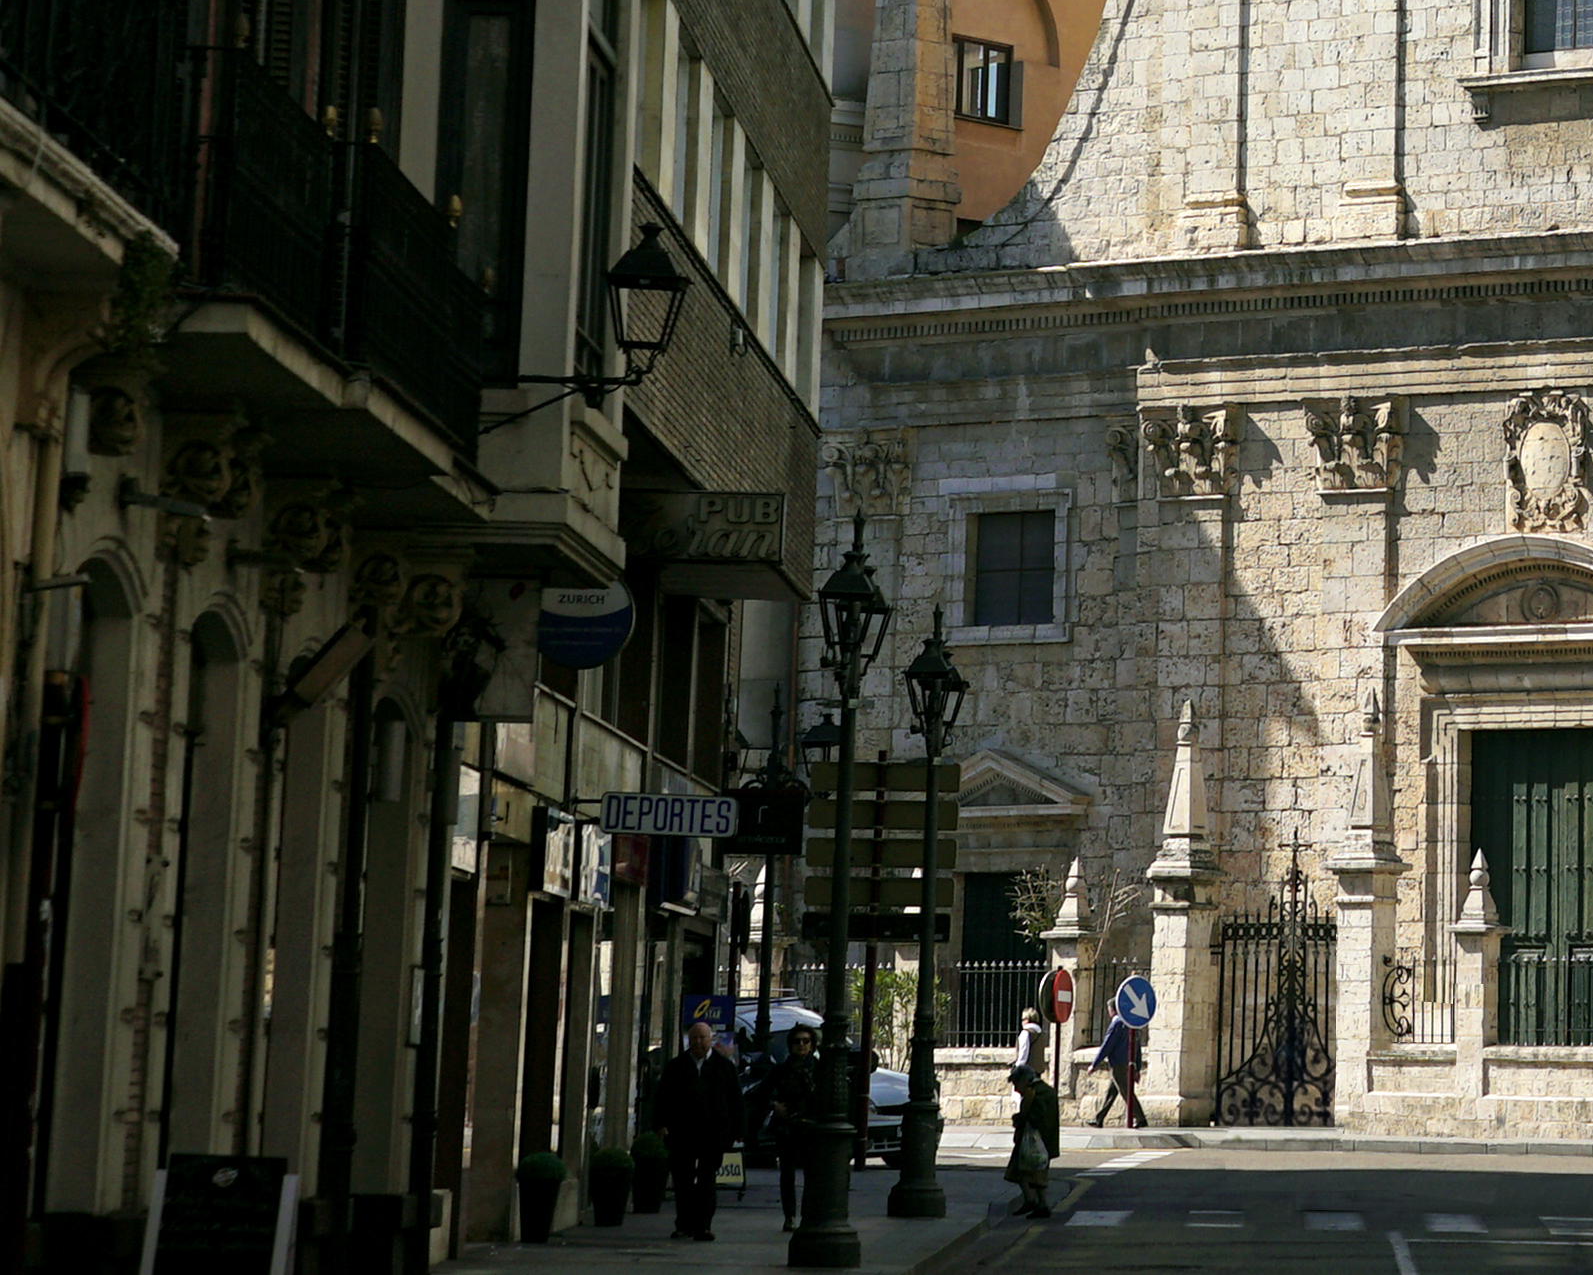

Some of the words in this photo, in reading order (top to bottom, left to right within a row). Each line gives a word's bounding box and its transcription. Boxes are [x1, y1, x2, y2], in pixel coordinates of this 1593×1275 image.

[699, 495, 779, 524] PUB
[558, 594, 605, 604] ZURICH
[605, 795, 732, 833] DEPORTES
[715, 1164, 741, 1176] osta
